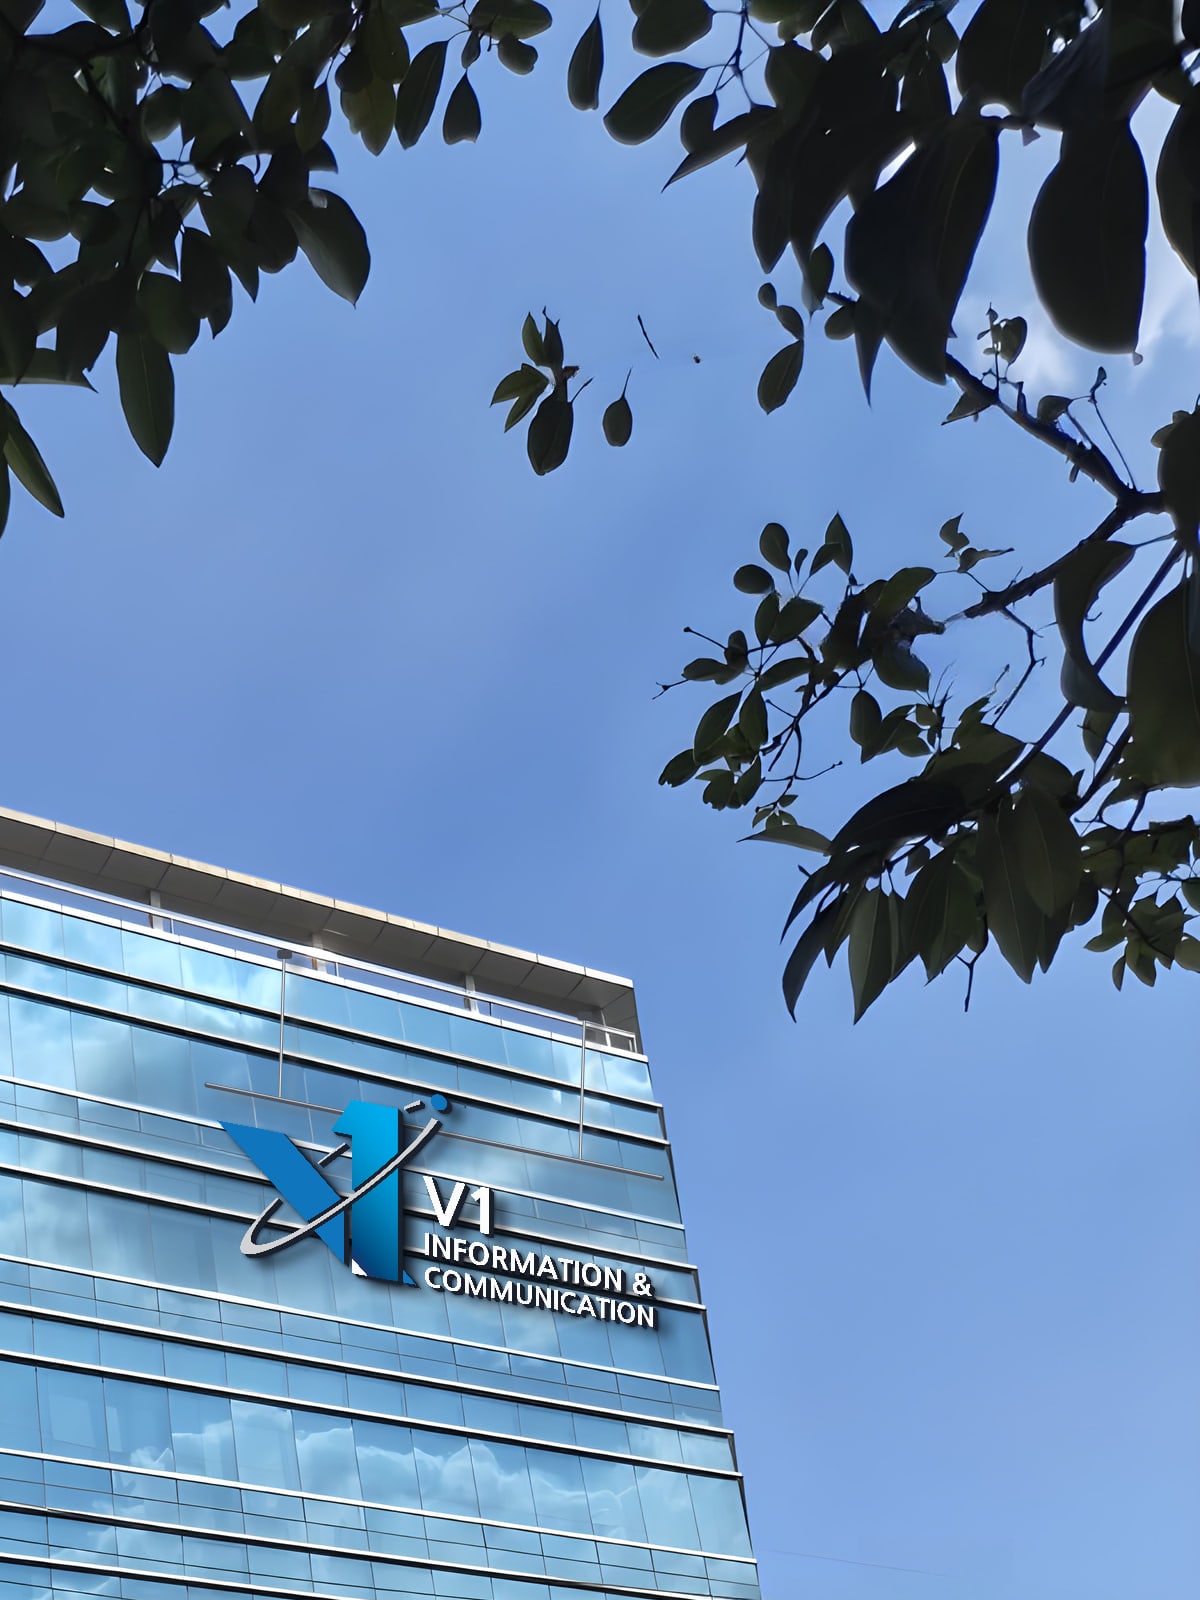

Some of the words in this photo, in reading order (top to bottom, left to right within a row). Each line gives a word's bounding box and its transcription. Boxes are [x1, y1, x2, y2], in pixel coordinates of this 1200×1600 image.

[422, 1175, 493, 1236] V1
[424, 1231, 624, 1292] INFORMATION
[631, 1271, 654, 1297] &
[424, 1266, 656, 1329] COMMUNICATION
